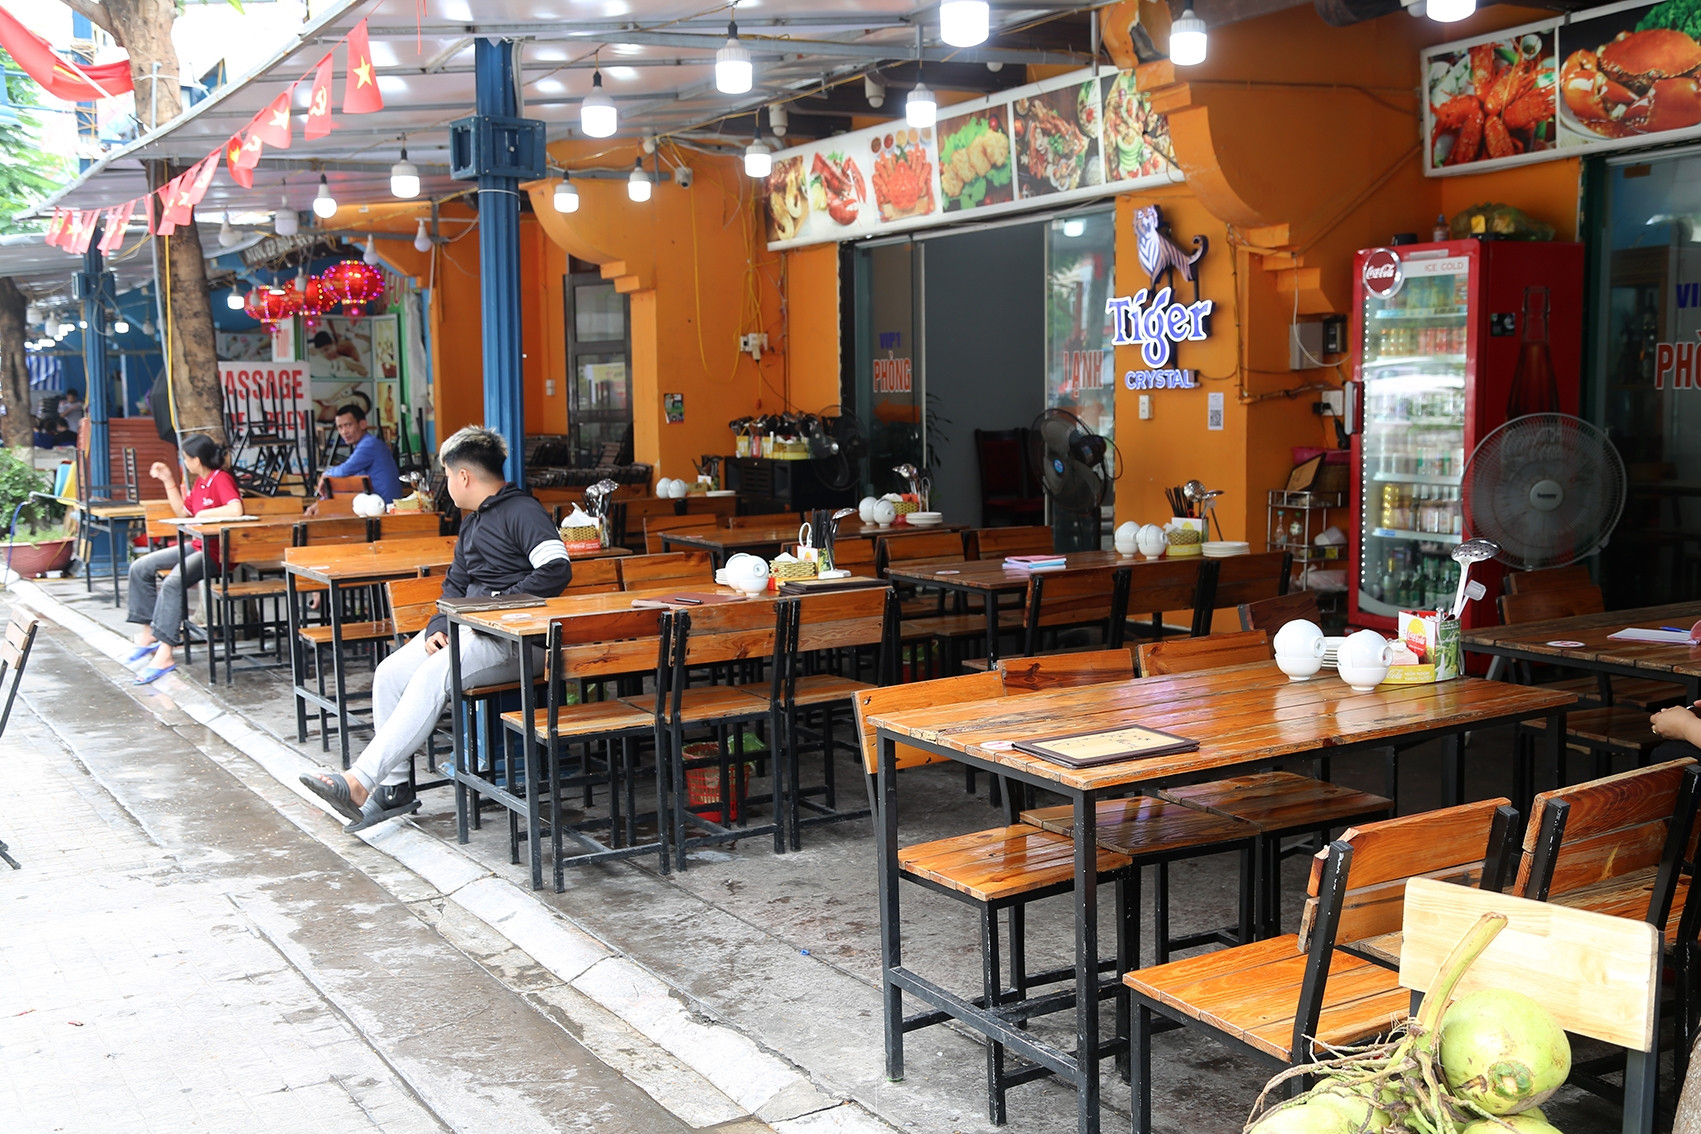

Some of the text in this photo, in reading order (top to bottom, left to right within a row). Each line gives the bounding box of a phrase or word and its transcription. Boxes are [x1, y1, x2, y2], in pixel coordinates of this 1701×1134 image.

[1424, 261, 1464, 272] ICE COLD
[1105, 286, 1213, 369] Tiger
[873, 350, 912, 393] PHÒNG
[1125, 369, 1195, 390] CRYSTAL
